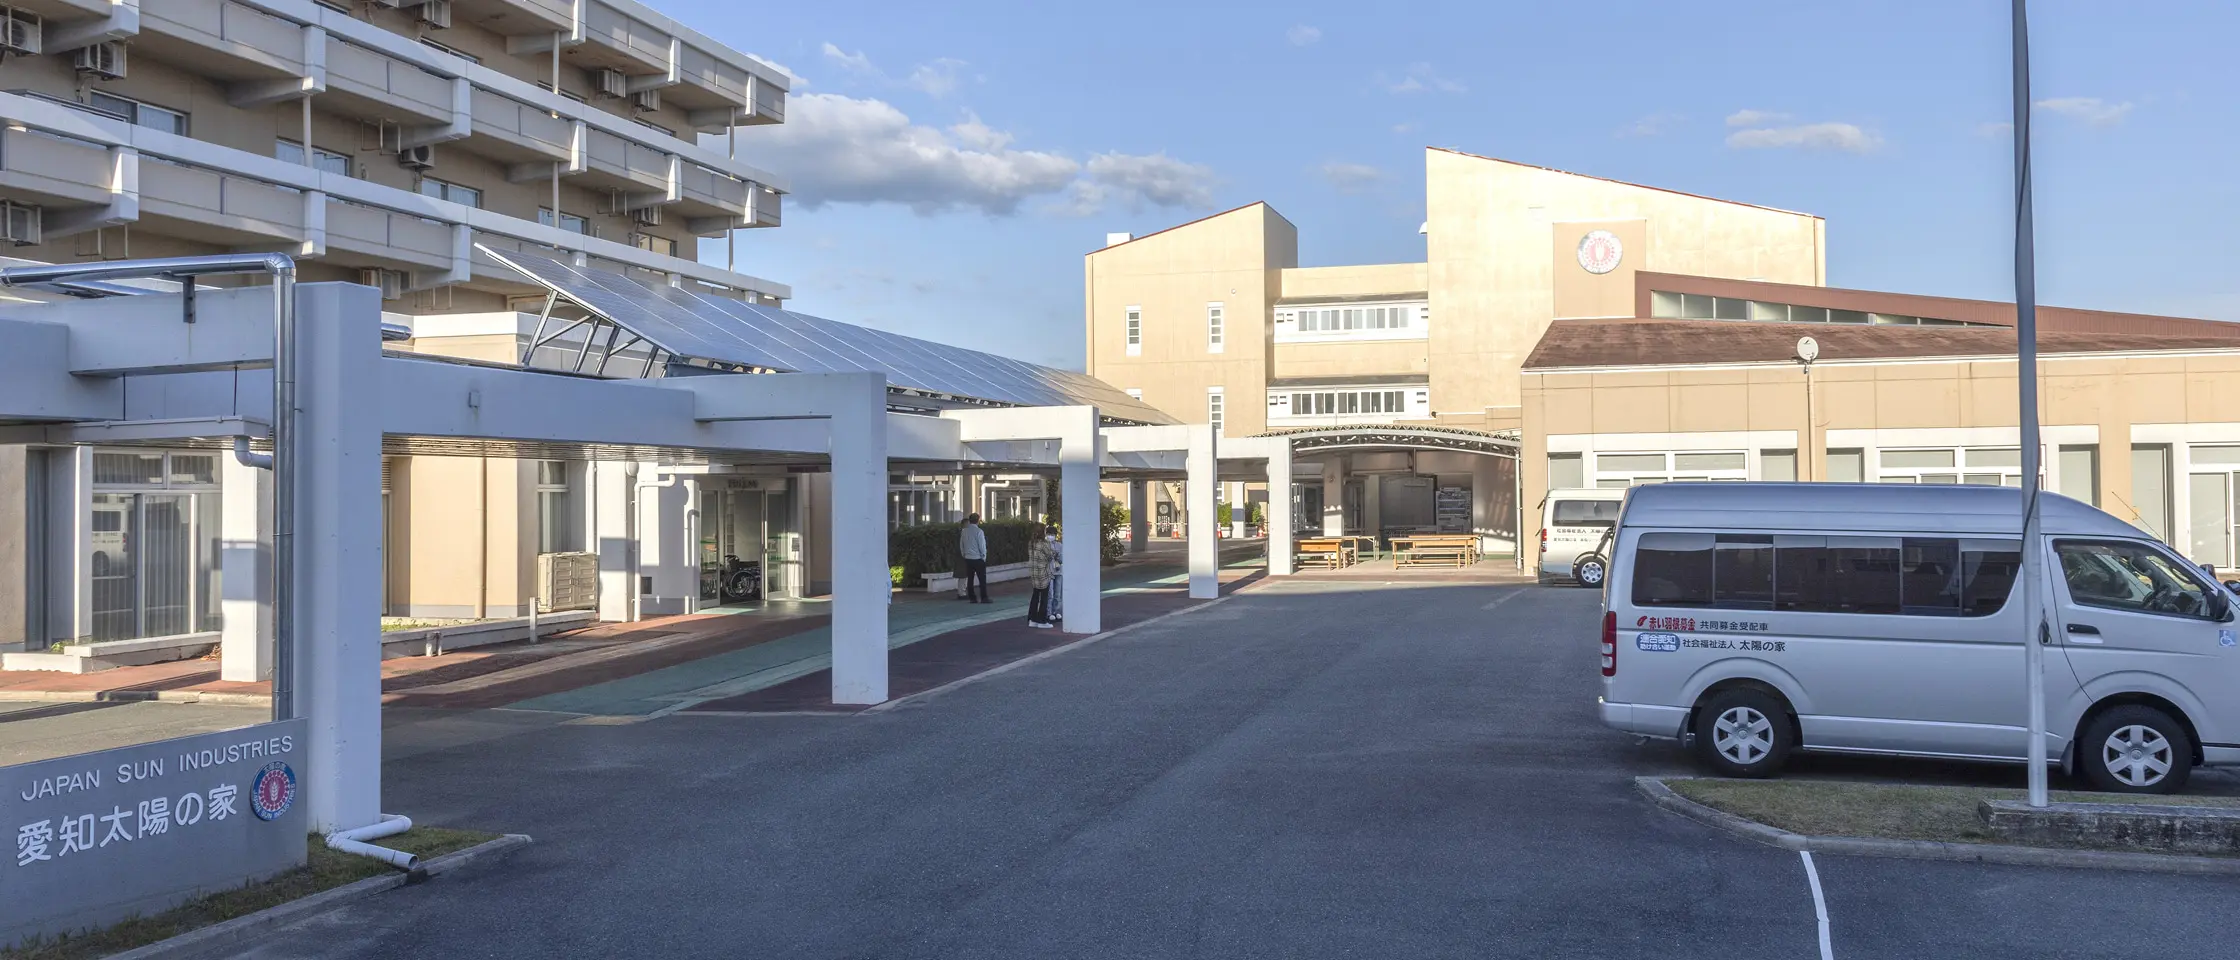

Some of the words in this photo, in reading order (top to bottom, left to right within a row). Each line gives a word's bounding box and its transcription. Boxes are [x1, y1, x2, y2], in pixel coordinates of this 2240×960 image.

[1649, 616, 1695, 631] 赤い羽根募金
[1700, 620, 1769, 631] 共同募金受配車
[1682, 638, 1736, 650] 社会福祉法人
[1739, 640, 1786, 652] 太陽の家
[21, 769, 100, 801] JAPAN
[117, 758, 164, 783] SUN
[179, 735, 293, 772] INDUSTRIES
[17, 783, 238, 867] 愛知太陽の家
